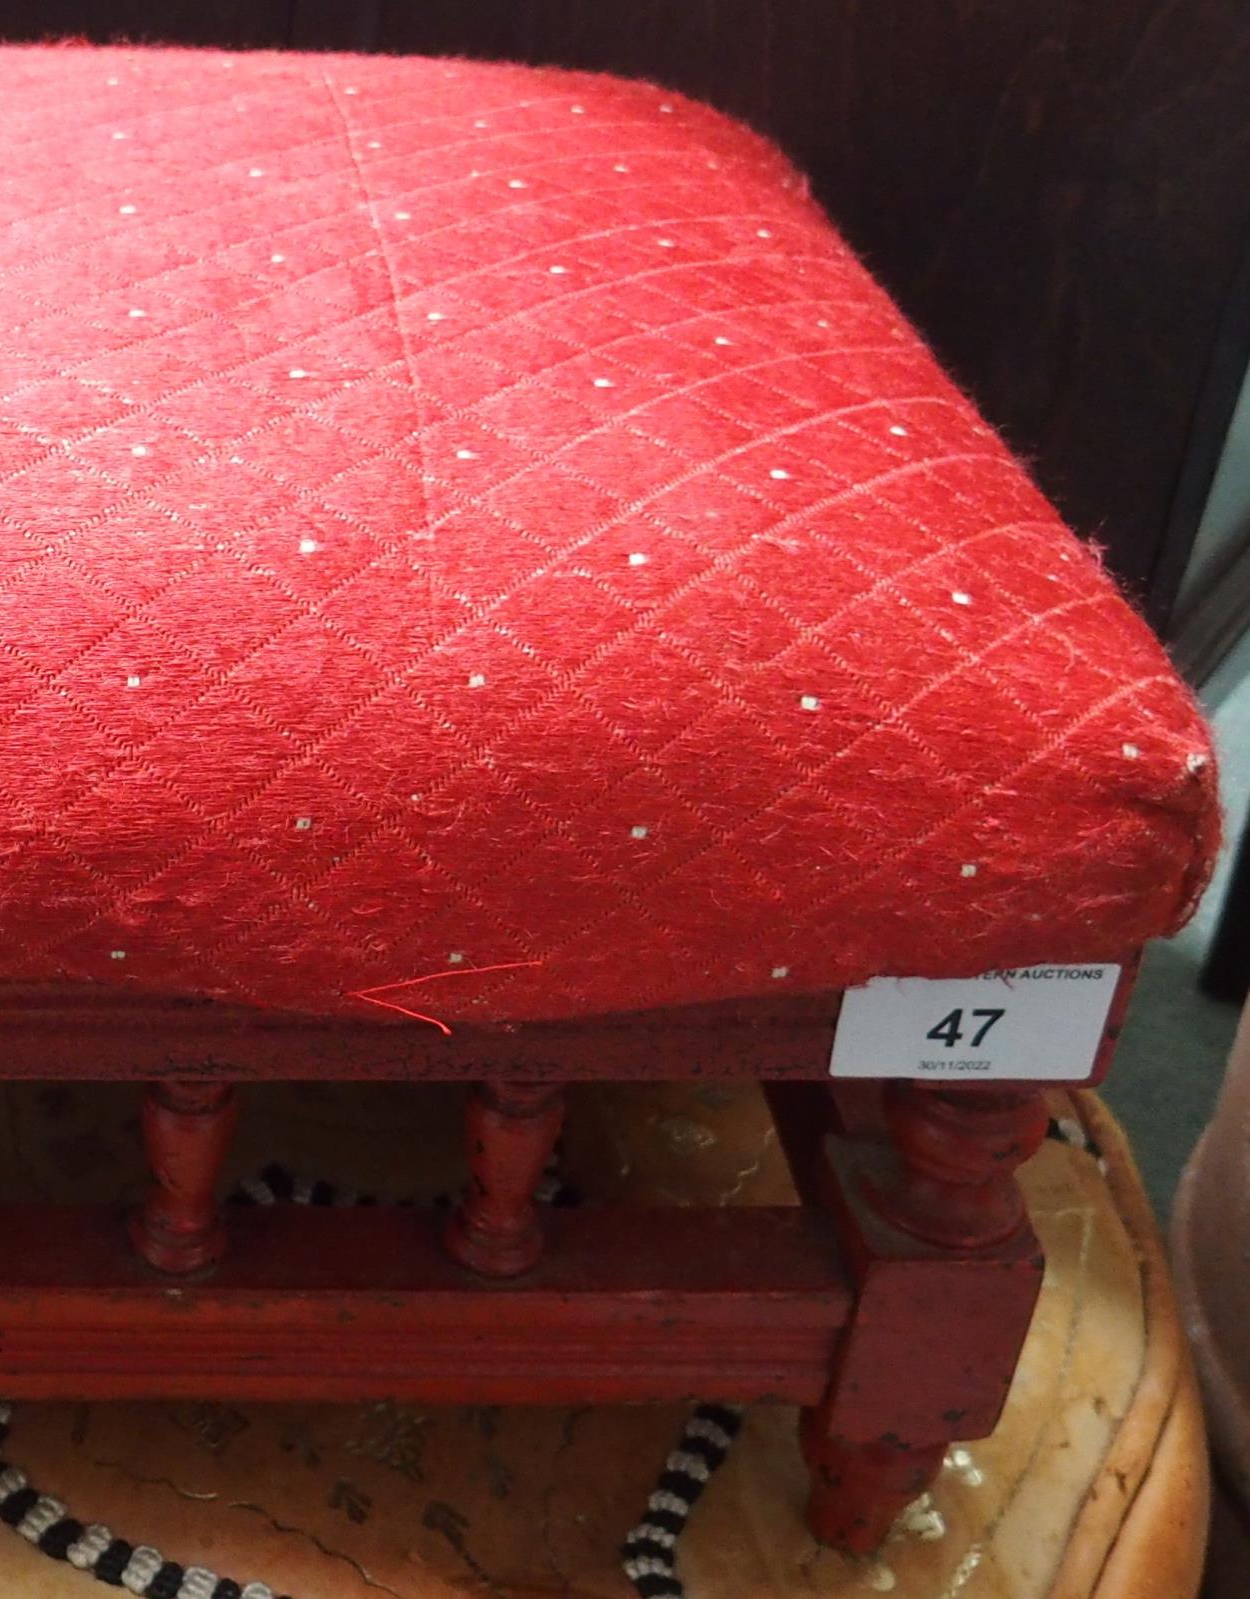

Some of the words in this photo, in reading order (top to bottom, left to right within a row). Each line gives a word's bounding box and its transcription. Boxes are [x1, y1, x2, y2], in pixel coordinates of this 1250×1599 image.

[1020, 969, 1103, 980] AUCTIONS
[926, 1008, 1005, 1047] 47
[917, 1060, 991, 1070] 30/11/2022
